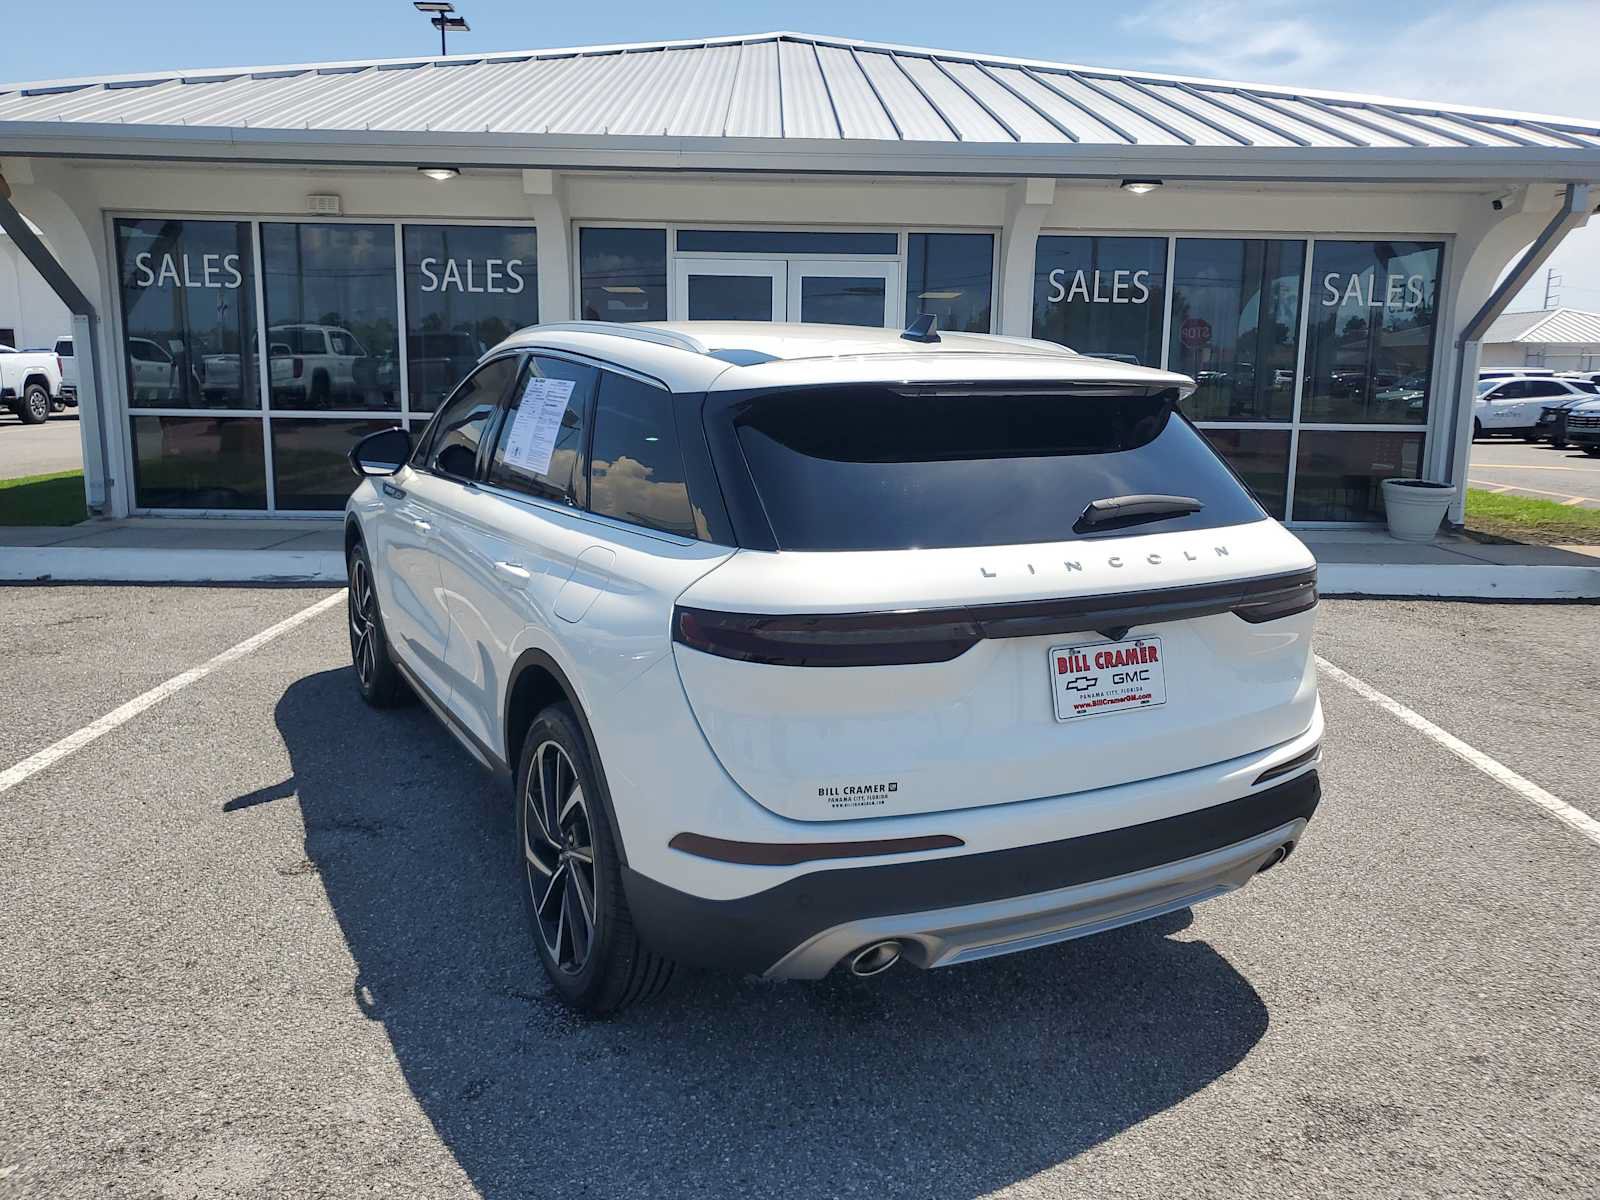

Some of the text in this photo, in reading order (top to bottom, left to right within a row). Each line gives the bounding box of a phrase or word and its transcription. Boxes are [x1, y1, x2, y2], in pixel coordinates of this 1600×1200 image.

[135, 252, 242, 289] SALES
[420, 257, 525, 294] SALES
[1047, 268, 1150, 304] SALES
[1321, 272, 1423, 308] SALES
[980, 545, 1230, 578] LINCOLN
[1057, 645, 1159, 675] BILL CRAMER
[1112, 669, 1151, 685] GMC
[1079, 691, 1105, 700] PANAMA
[818, 786, 840, 797] BILL
[843, 784, 886, 795] CRAMER
